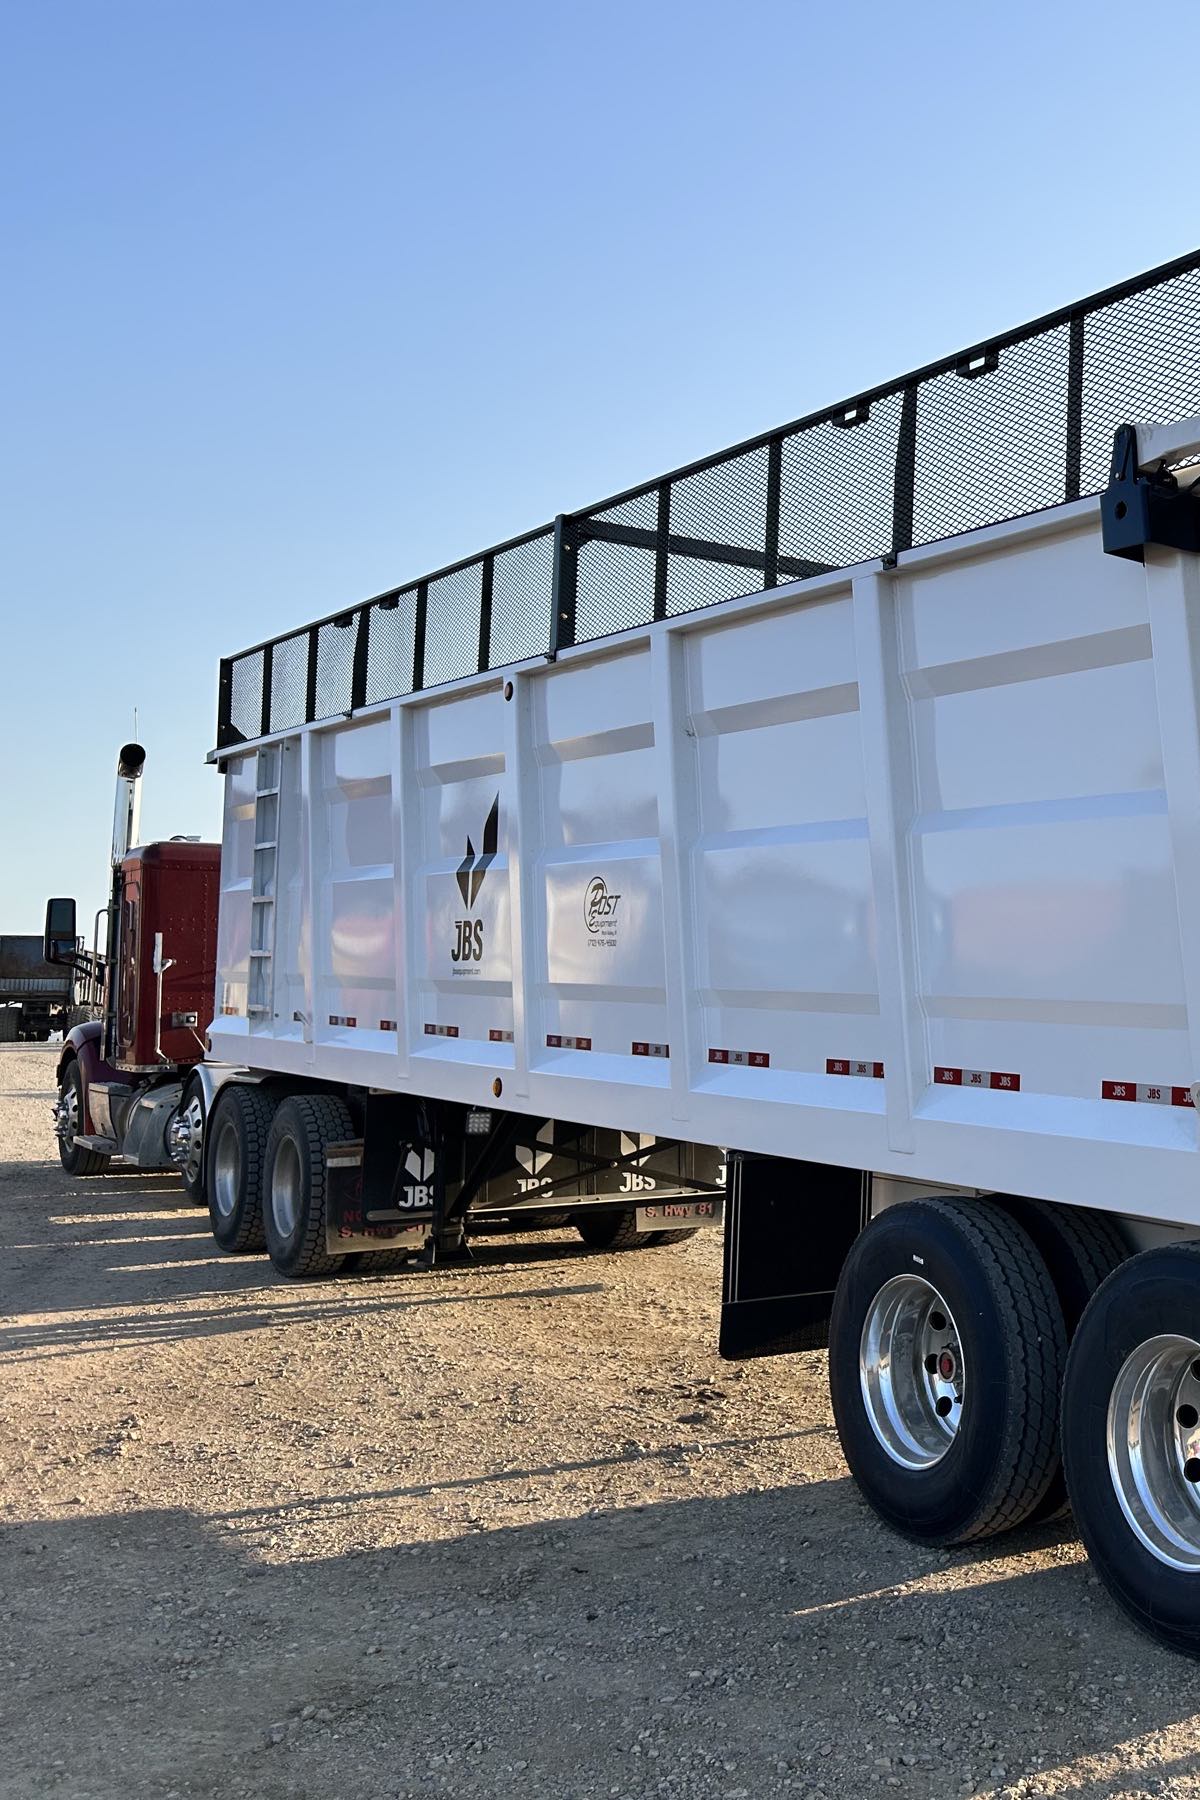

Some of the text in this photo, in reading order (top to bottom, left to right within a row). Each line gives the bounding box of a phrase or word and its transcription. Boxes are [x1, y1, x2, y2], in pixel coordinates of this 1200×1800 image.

[451, 919, 484, 962] JBS
[833, 1062, 867, 1073] JBS JBS
[942, 1070, 1011, 1087] JBS JBS JBS
[1112, 1085, 1193, 1103] JBS JBS JB
[619, 1171, 656, 1193] JBS
[645, 1202, 713, 1219] S. Hwy 81
